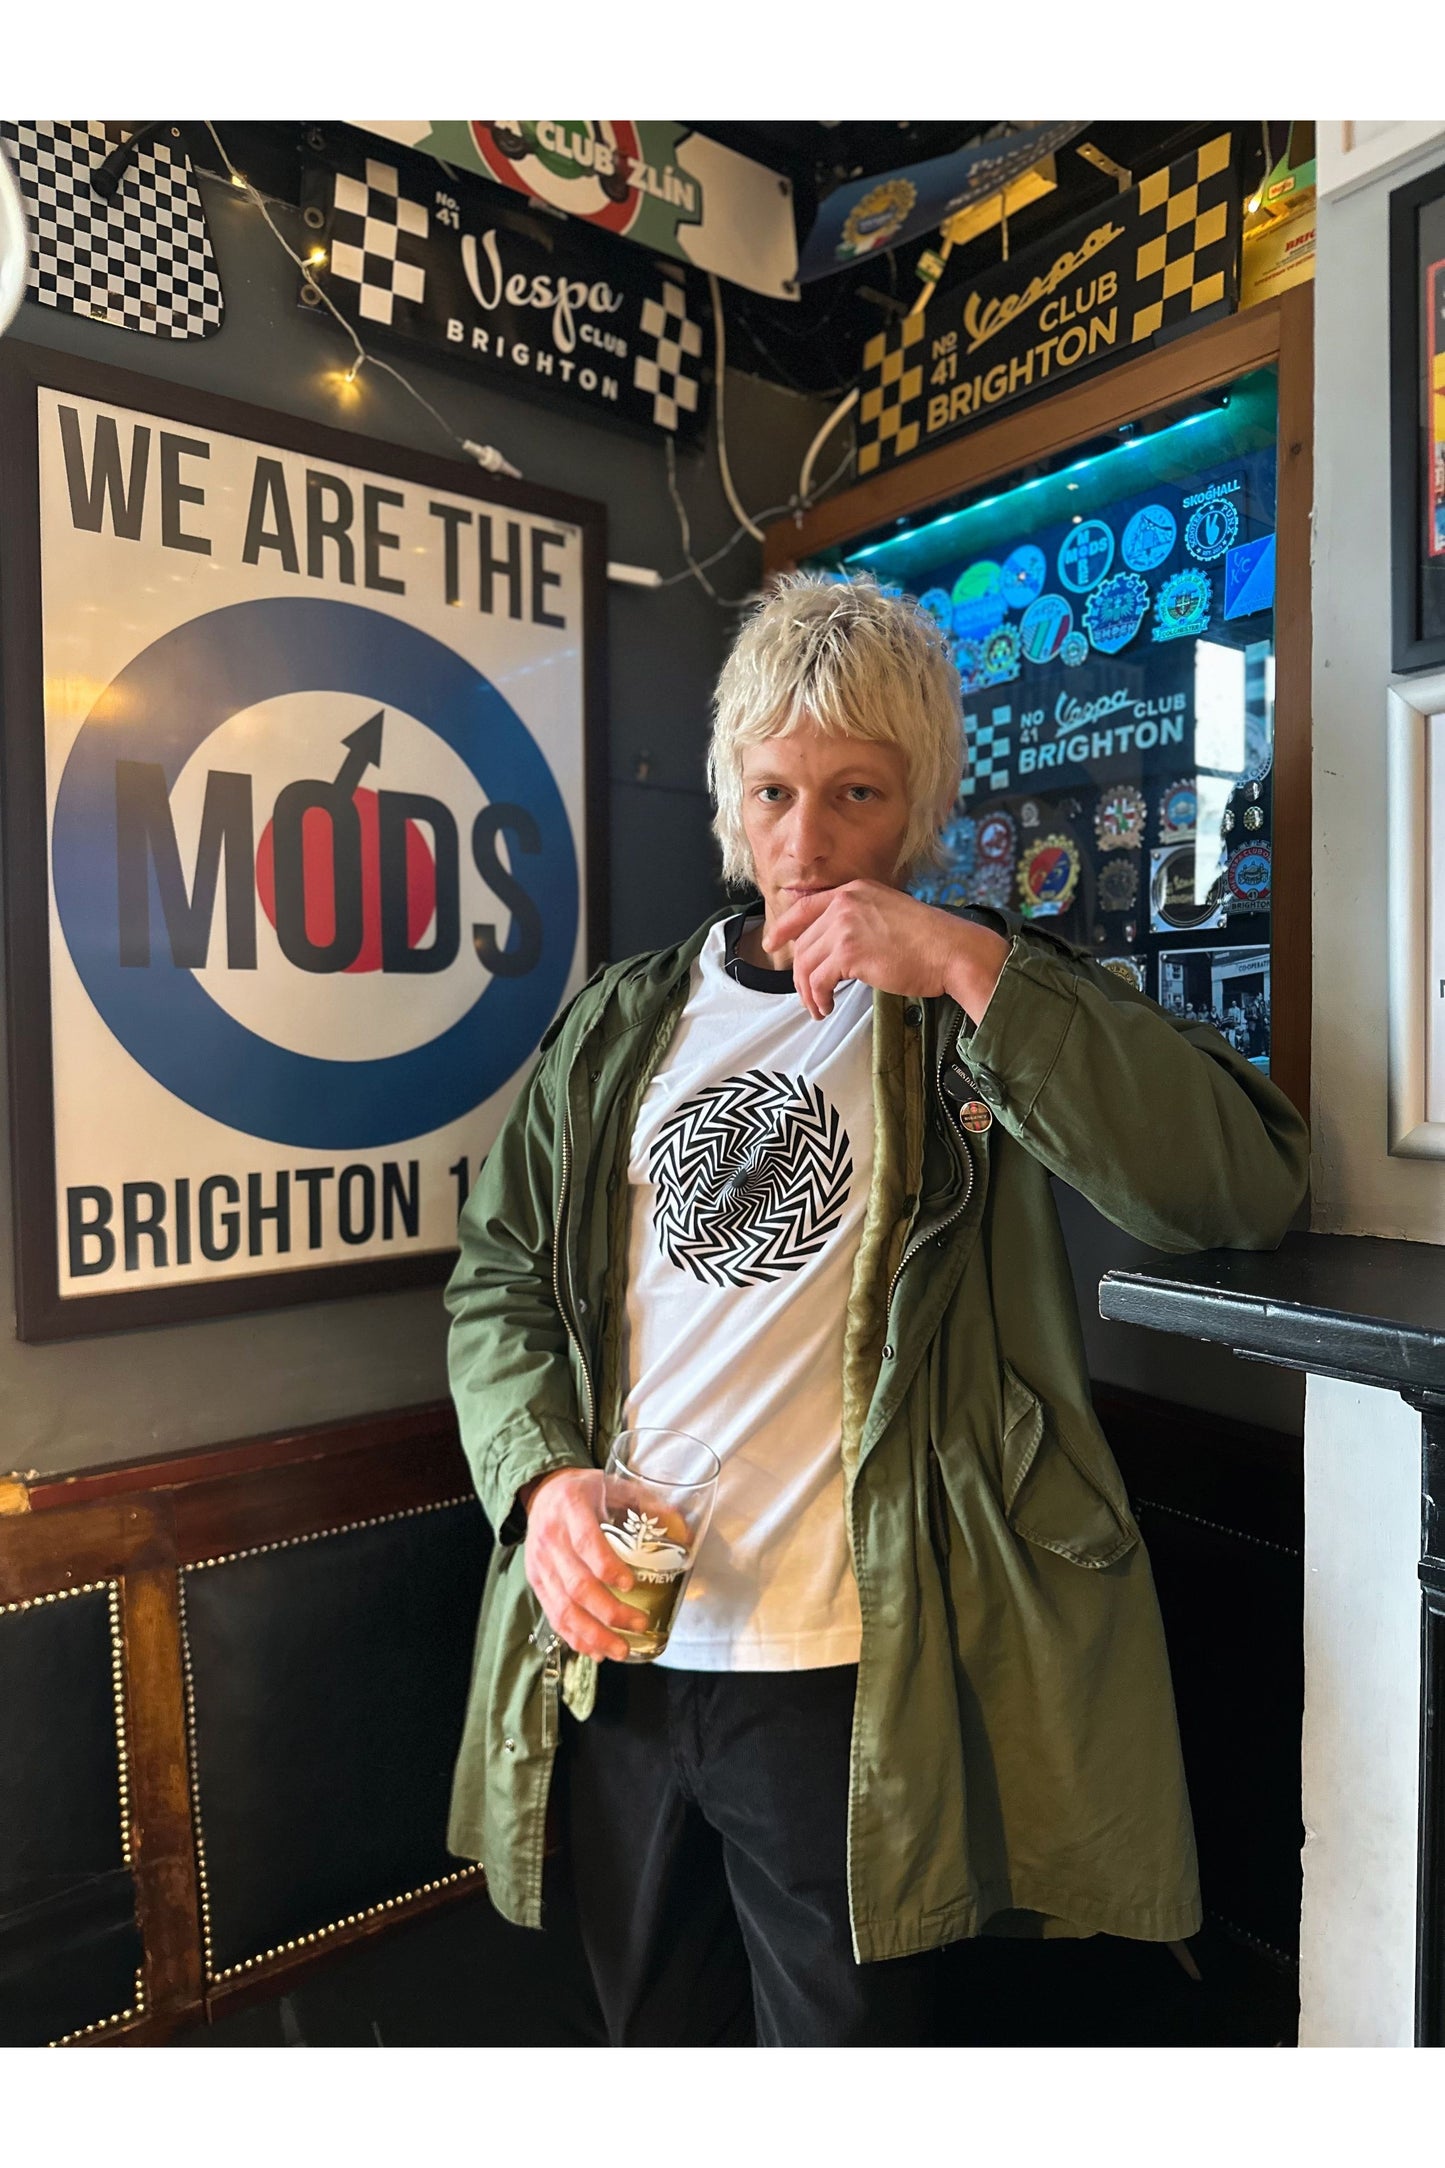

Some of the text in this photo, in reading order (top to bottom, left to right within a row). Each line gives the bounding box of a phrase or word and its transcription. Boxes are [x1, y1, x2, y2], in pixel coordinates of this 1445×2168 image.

[535, 121, 616, 176] CLUB
[626, 156, 696, 212] ZLÍN
[435, 208, 460, 230] 41
[461, 229, 624, 354] Vespa
[963, 221, 1126, 355] Vespa
[1038, 270, 1118, 332] CLUB
[446, 318, 619, 401] BRIGHTON
[579, 323, 628, 358] CLUB
[926, 306, 1119, 433] BRIGHTON
[930, 353, 958, 385] 41
[57, 403, 567, 630] WE ARE THE
[1065, 537, 1108, 565] MODS
[1019, 727, 1039, 744] 41
[1020, 709, 1045, 729] NO
[1054, 688, 1187, 738] Vespa CLUB
[1018, 714, 1184, 775] BRIGHTON
[114, 759, 544, 979] MODS
[66, 1153, 489, 1278] BRIGHTON 1
